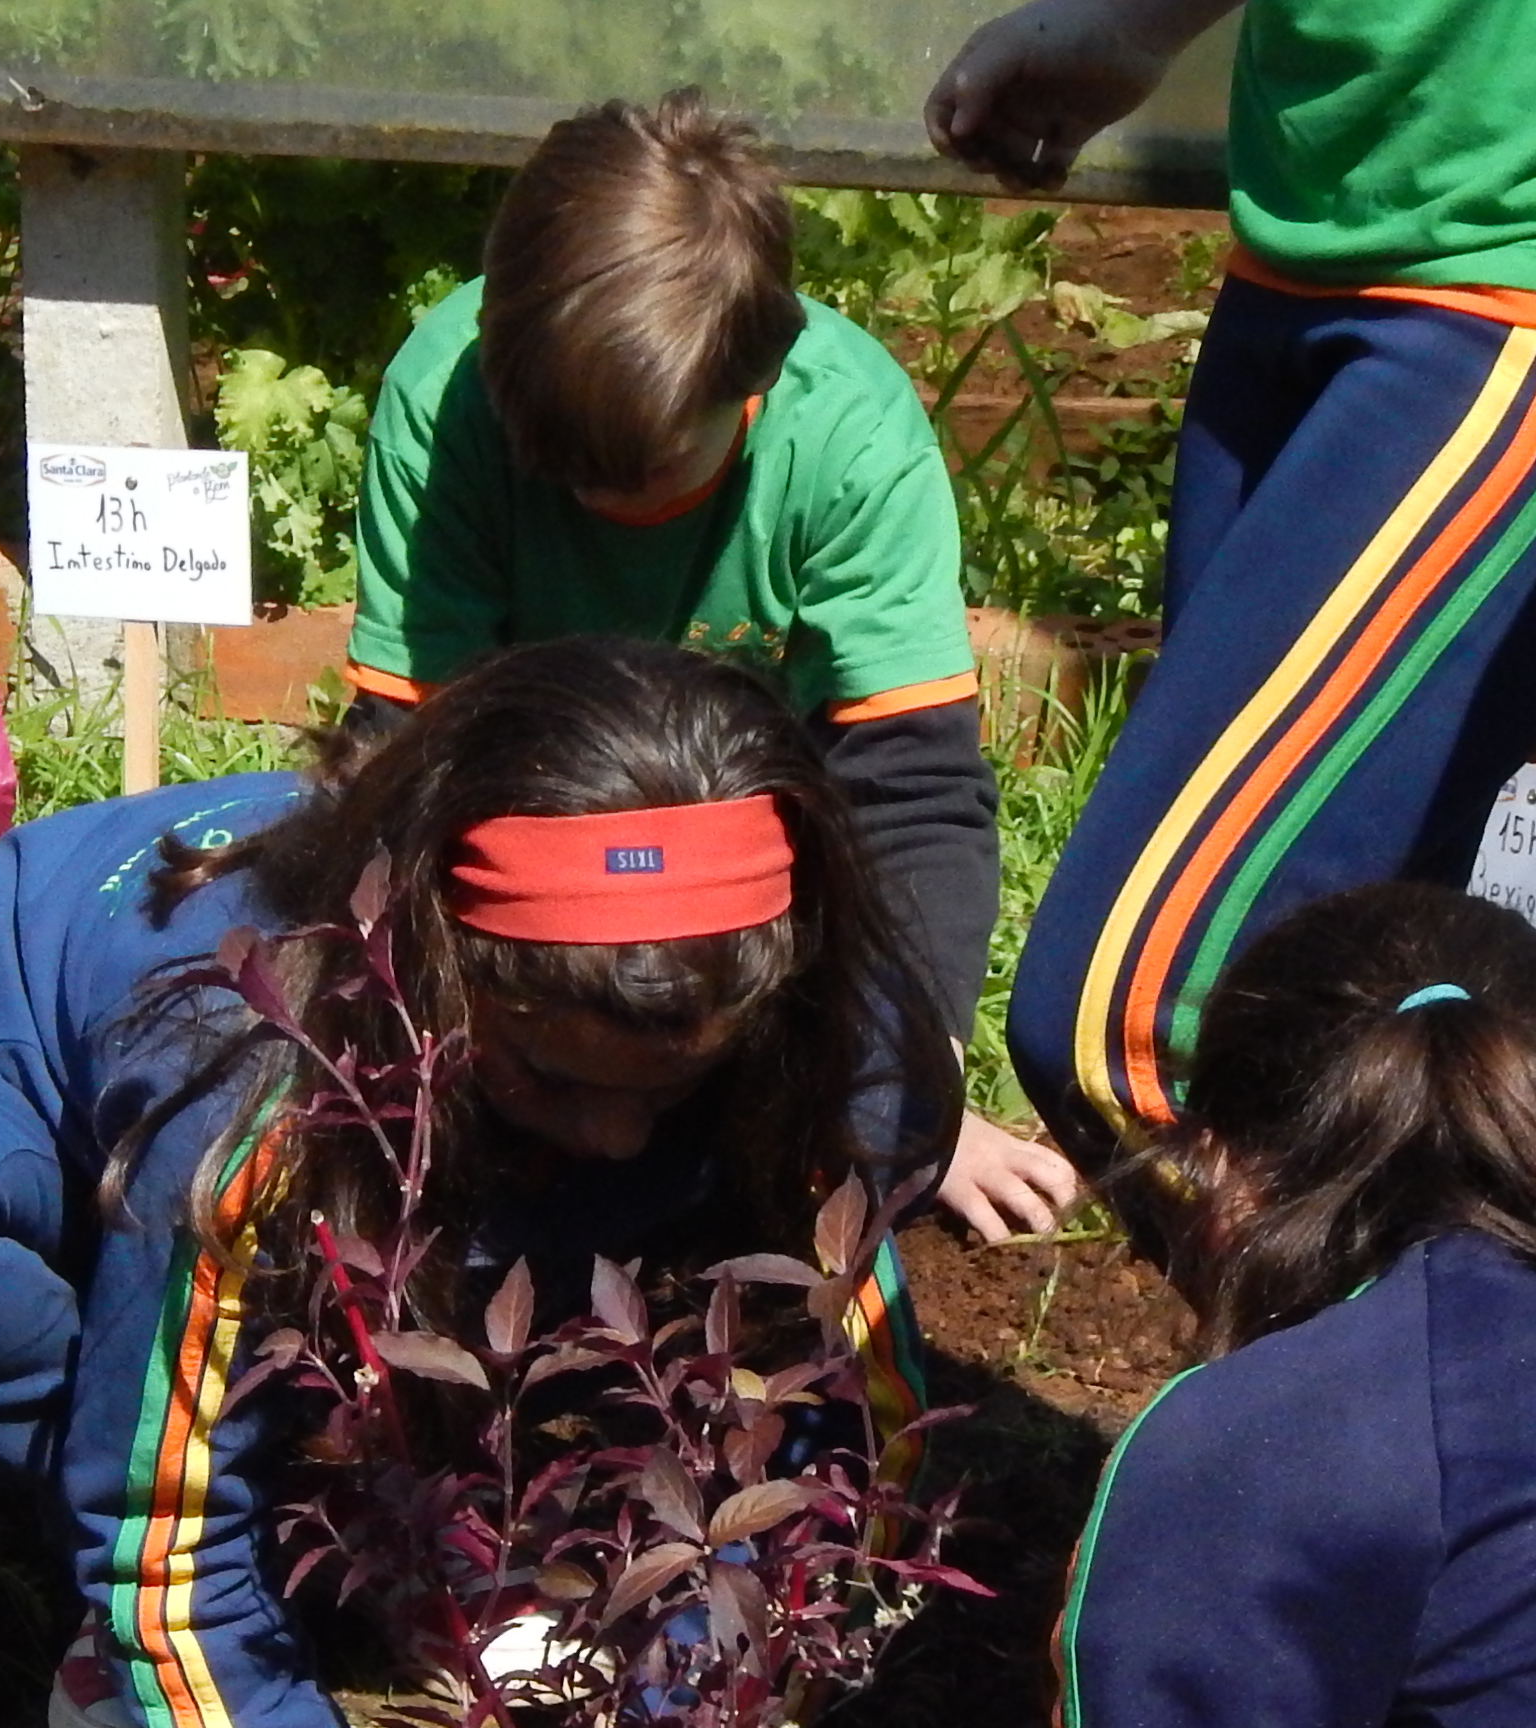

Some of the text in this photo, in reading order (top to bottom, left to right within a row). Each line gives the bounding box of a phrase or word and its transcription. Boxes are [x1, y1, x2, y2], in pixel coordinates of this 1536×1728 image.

[43, 462, 105, 477] Santa Clara
[163, 546, 227, 582] Delgado
